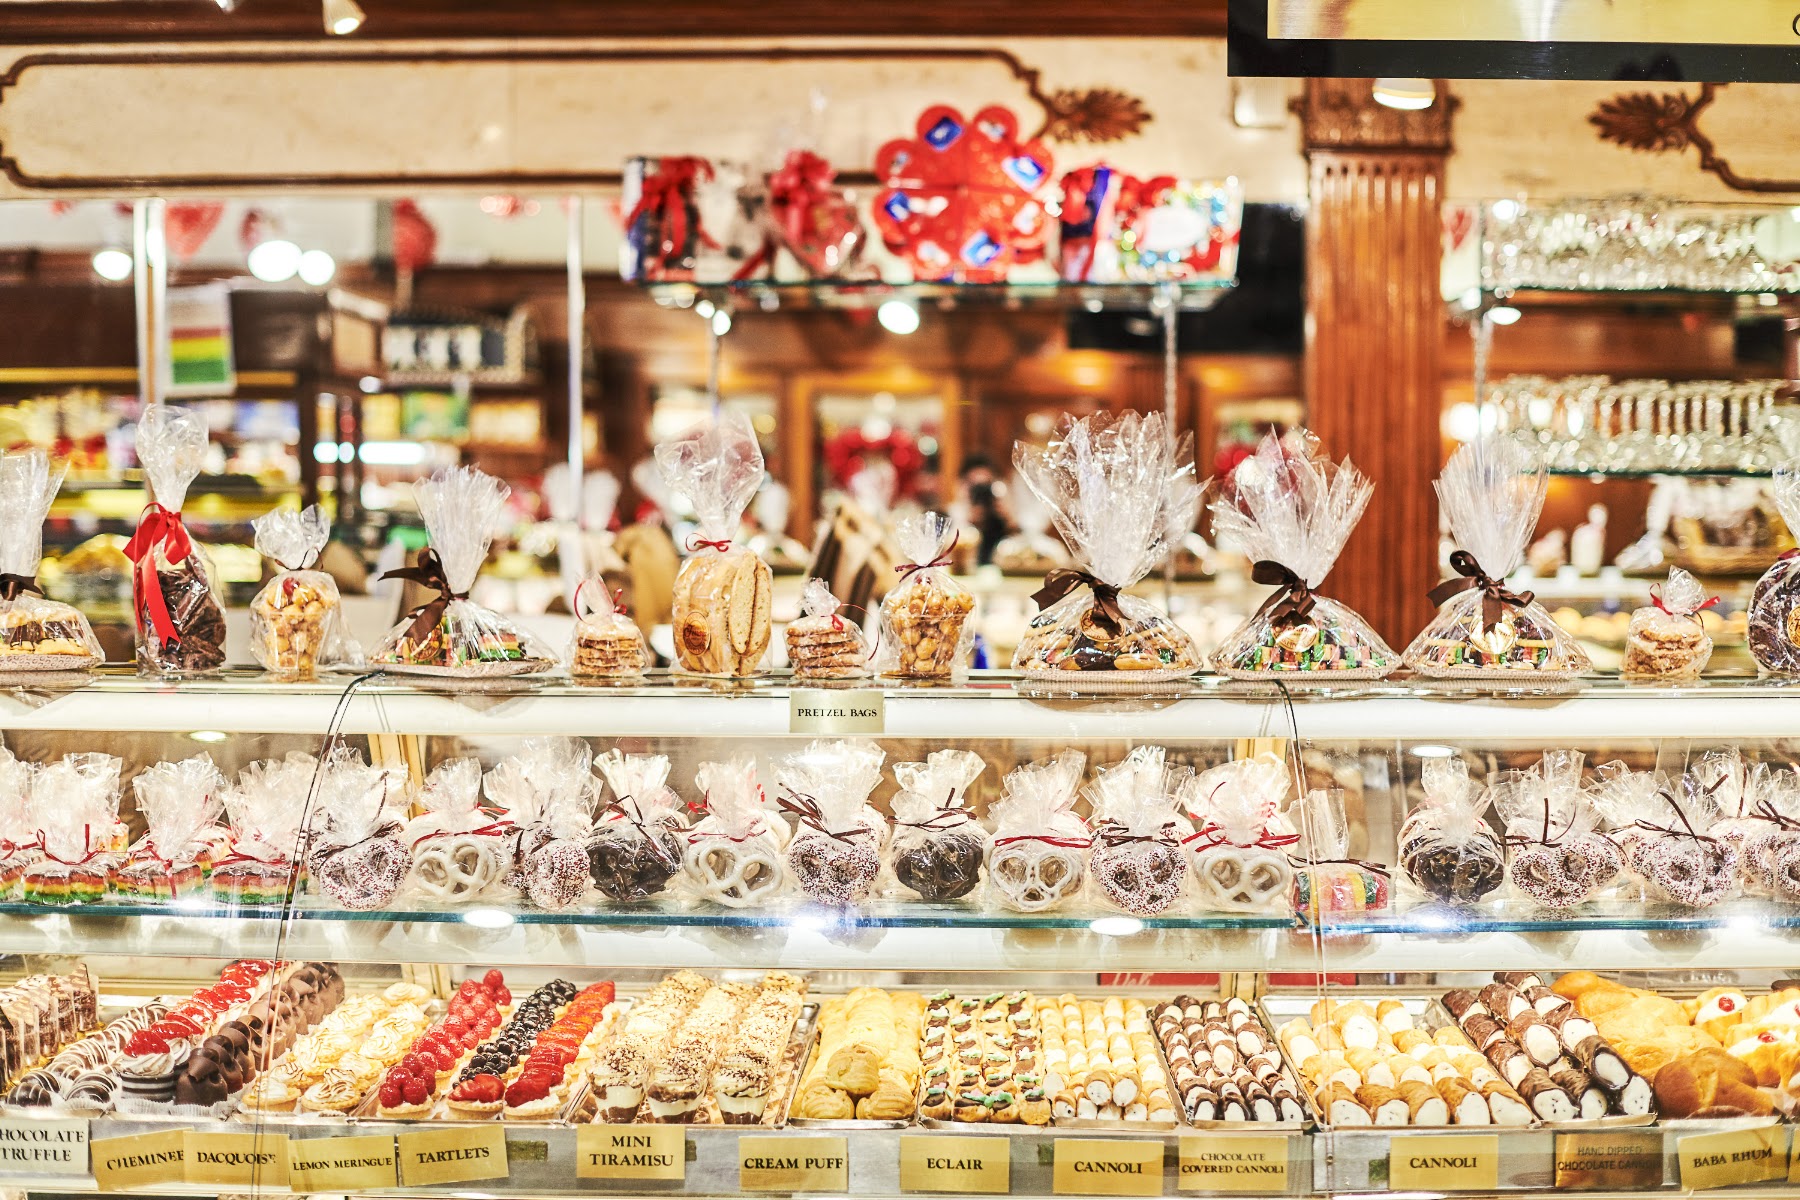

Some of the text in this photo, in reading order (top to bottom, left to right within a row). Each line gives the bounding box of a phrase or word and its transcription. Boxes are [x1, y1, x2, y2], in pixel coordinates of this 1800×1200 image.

[797, 708, 877, 717] PRETZEL BAGS
[0, 1128, 85, 1143] HOCOLATE
[611, 1135, 652, 1148] MINI
[0, 1147, 71, 1162] TRUFFLE
[416, 1146, 490, 1164] TARTLETS
[1200, 1152, 1266, 1161] CHOCOLATE
[1606, 1145, 1643, 1156] DIPPED
[292, 1157, 393, 1171] LEMON MERINGUE
[589, 1153, 674, 1167] TIRAMISU
[743, 1157, 844, 1169] CREAM PUFF
[926, 1157, 984, 1170] ECLAIR
[1409, 1157, 1477, 1169] CANNOLI
[1693, 1147, 1773, 1168] BABA RHUM
[1074, 1160, 1143, 1174] CANNOLI
[1181, 1164, 1284, 1174] COVERED CANNOLI
[1557, 1160, 1616, 1171] CHOCOLATE
